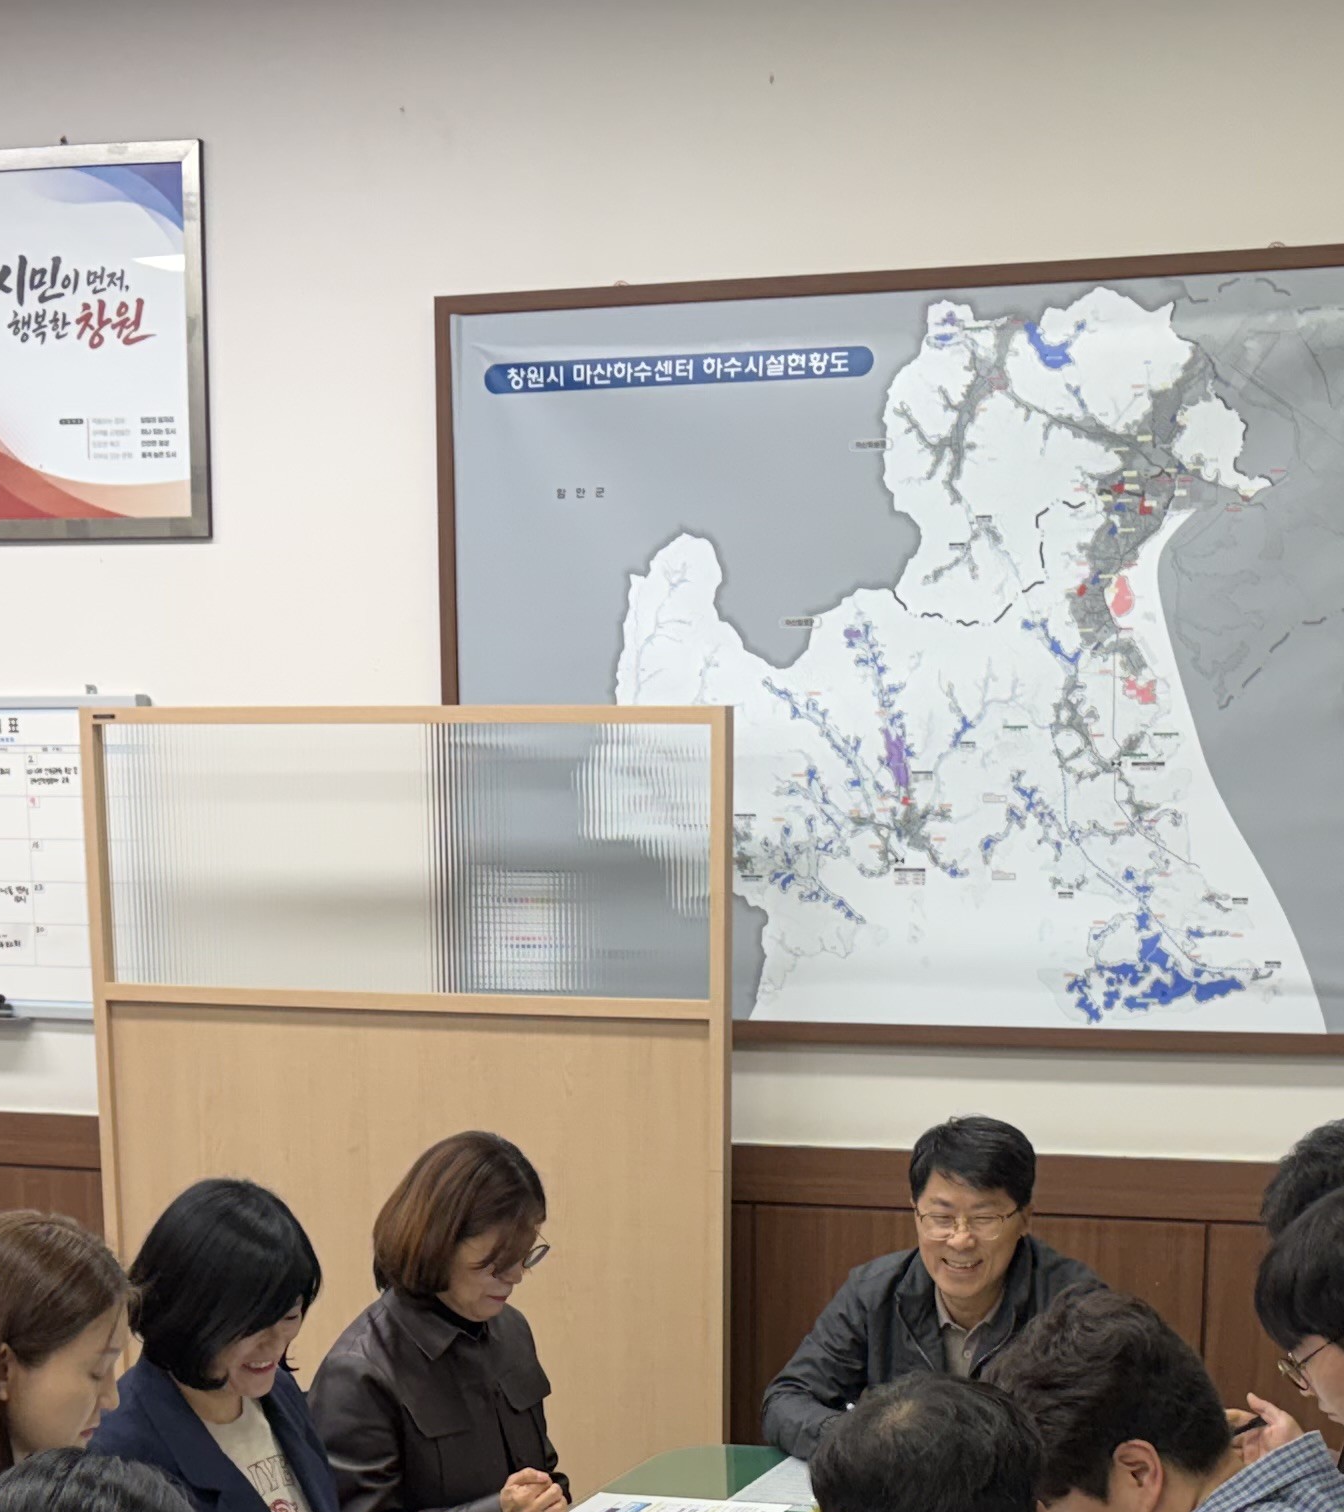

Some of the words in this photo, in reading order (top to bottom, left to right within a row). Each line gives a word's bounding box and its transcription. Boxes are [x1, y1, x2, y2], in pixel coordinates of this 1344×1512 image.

[87, 267, 130, 295] 먼저,
[7, 309, 71, 344] 행복한
[75, 298, 157, 349] 창원
[507, 365, 565, 391] 창원시
[572, 358, 695, 386] 마산하수센터
[702, 351, 850, 380] 하수시설현황도
